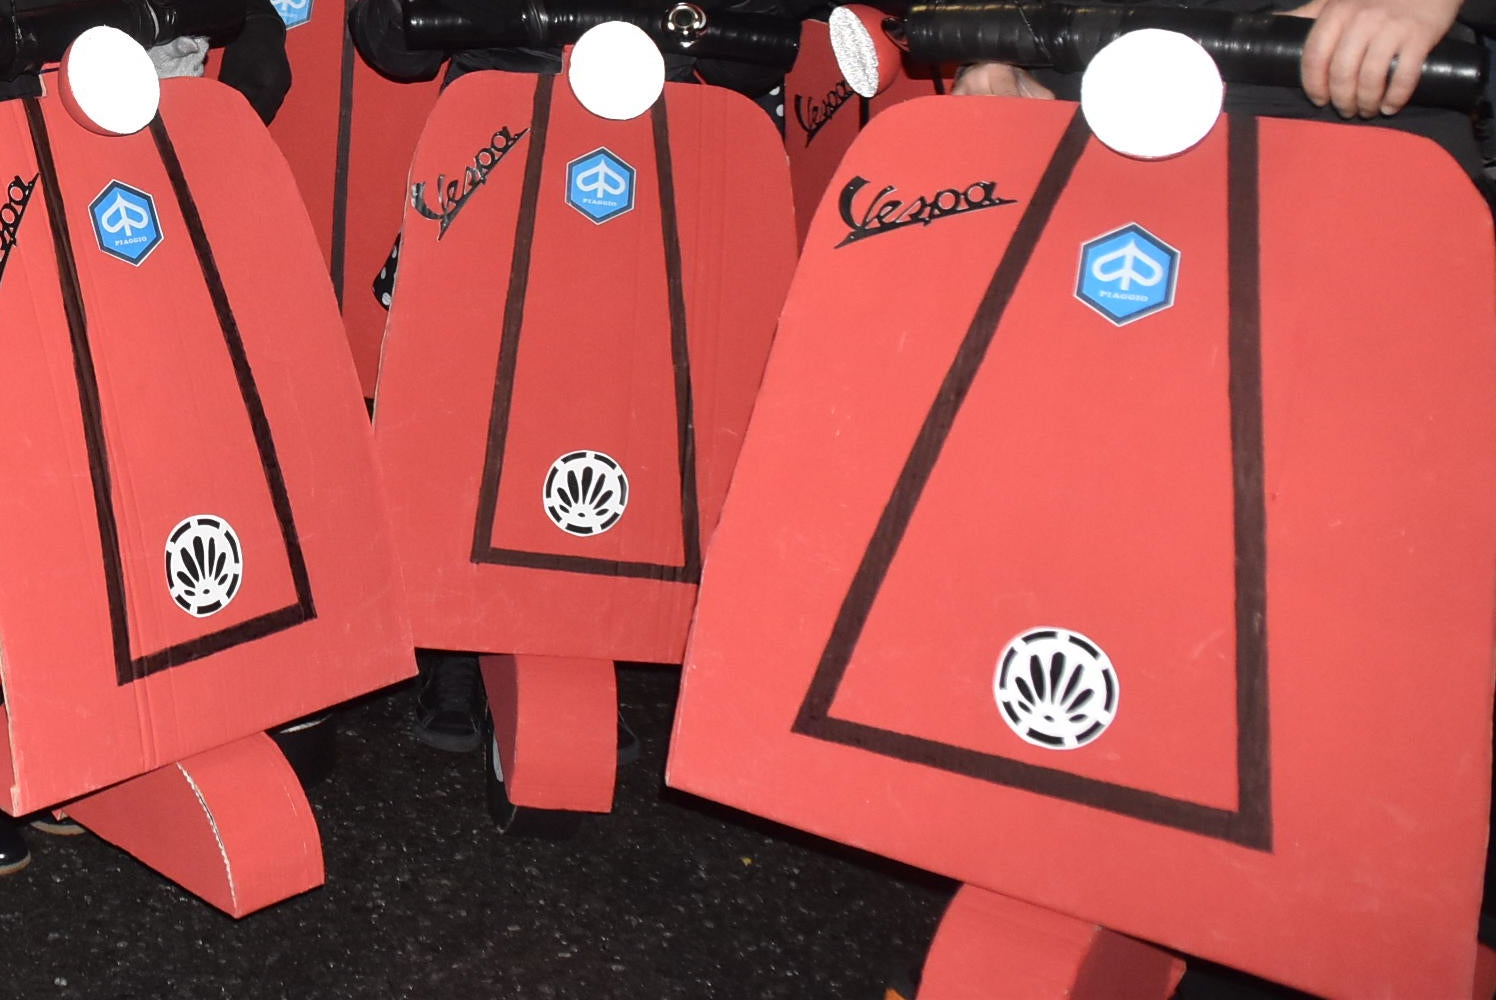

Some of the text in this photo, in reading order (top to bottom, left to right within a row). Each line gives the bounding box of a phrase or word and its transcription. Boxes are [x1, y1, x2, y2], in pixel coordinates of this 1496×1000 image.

[410, 125, 532, 242] Vespa
[834, 175, 1019, 250] Vespa
[115, 236, 147, 246] PIAGGIO
[1100, 290, 1149, 301] PIAGGIO
